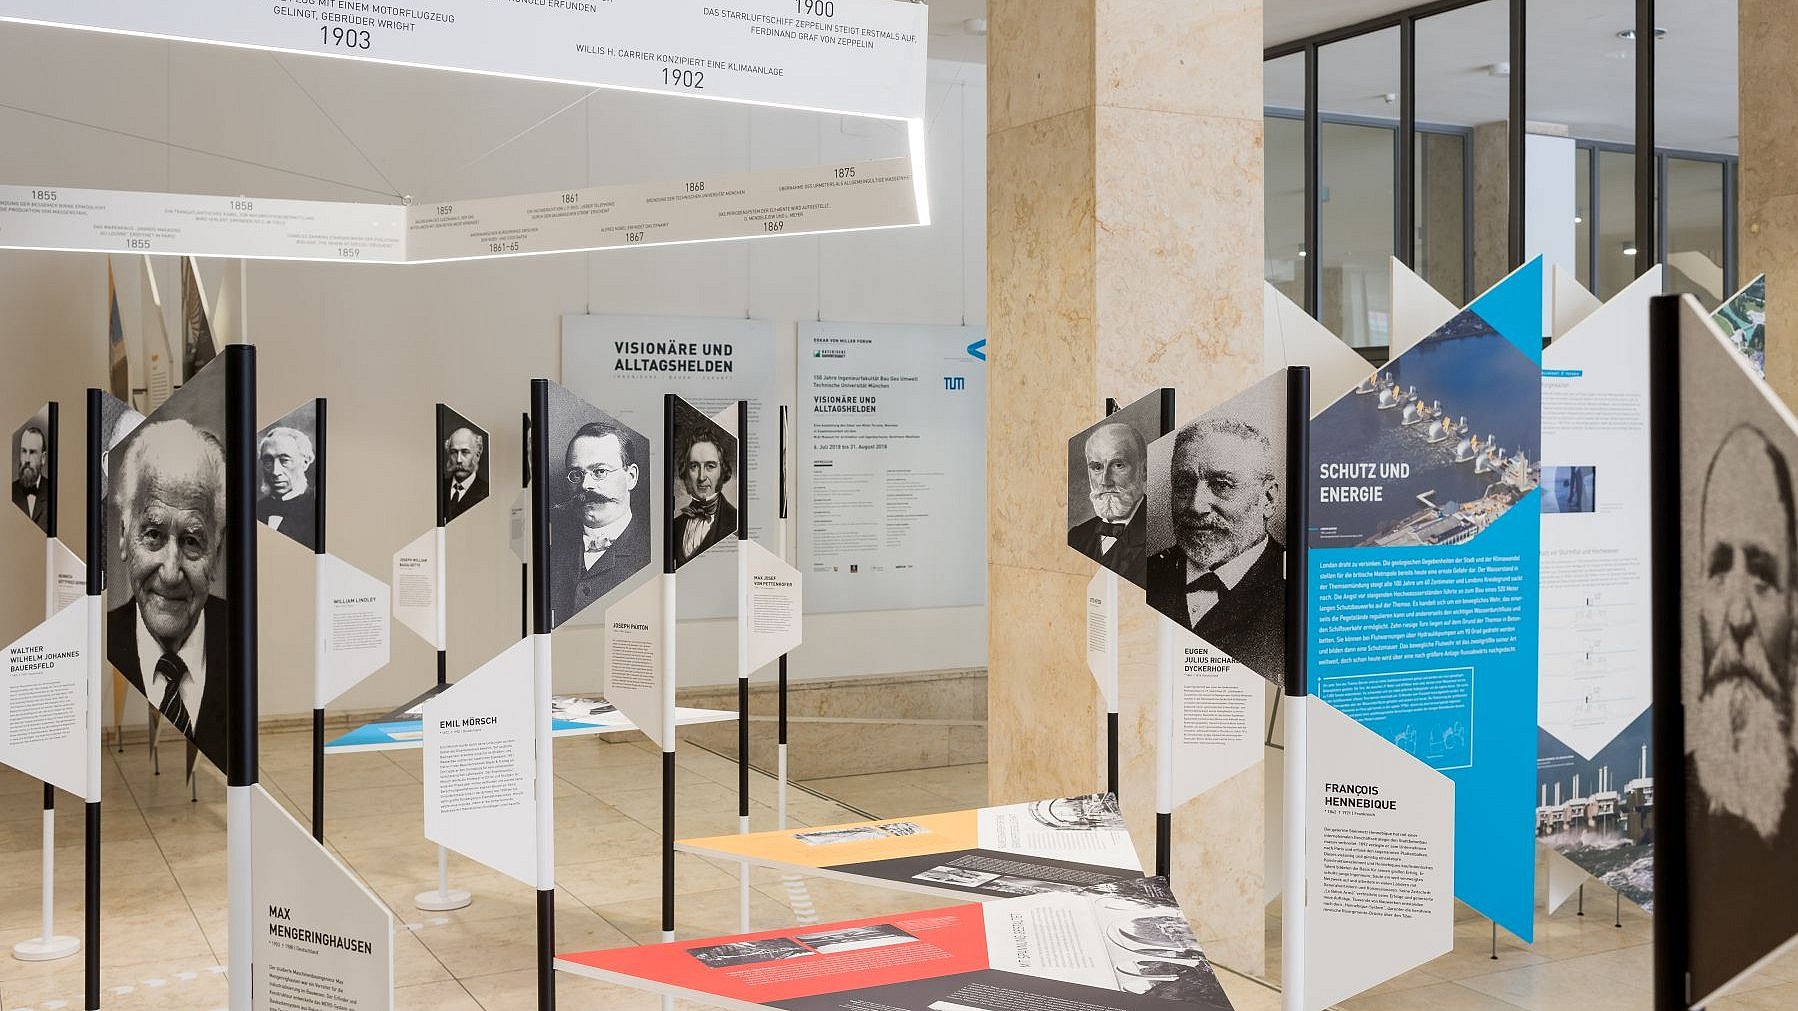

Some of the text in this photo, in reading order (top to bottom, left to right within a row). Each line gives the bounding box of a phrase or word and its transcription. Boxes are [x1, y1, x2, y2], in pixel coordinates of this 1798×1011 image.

[338, 0, 369, 12] EINEM
[372, 5, 455, 23] MOTORFLUGZEUG
[549, 0, 596, 12] ERFUNDEN
[795, 0, 834, 17] 1900
[274, 6, 415, 32] GELINGT, GEBRÜDER WRIGHT
[704, 8, 917, 44] DAS STARRLUFTSCHIFF ZEPPELIN STEIGT ERSTMALS AUF,
[320, 26, 370, 50] 1903
[751, 26, 874, 48] FERDINAND GRAF VON ZEPPELIN
[576, 44, 784, 76] WILLIS H. CARRIER KONZIPIERT EINE KLIMAANLAGE
[662, 68, 704, 89] 1902
[834, 167, 856, 178] 1875
[686, 182, 704, 192] 1868
[32, 190, 56, 200] 1855
[562, 193, 578, 203] 1861
[230, 201, 253, 210] 1858
[436, 206, 452, 215] 1859
[764, 220, 784, 232] 1869
[626, 232, 644, 242] 1867
[126, 240, 151, 248] 1855
[490, 242, 518, 252] 1861-65
[338, 248, 360, 258] 1859
[614, 340, 732, 356] VISIONÄRE UND
[614, 358, 732, 372] ALLTAGSHELDEN
[814, 394, 876, 404] VISIONÄRE UND
[1320, 463, 1410, 478] SCHUTZ UND
[1320, 486, 1382, 502] ENERGIE
[10, 646, 44, 654] WALTHER
[10, 650, 80, 664] WILHELM JOHANNES
[1184, 656, 1208, 664] JULIUS
[10, 662, 54, 672] BAUERSFELD
[440, 716, 497, 728] EMIL MÖRSCH
[1326, 783, 1378, 796] FRANÇOIS
[1325, 796, 1396, 810] HENNEBIQUE
[269, 905, 291, 921] MAX
[269, 923, 372, 954] MENGERINGHAUSEN
